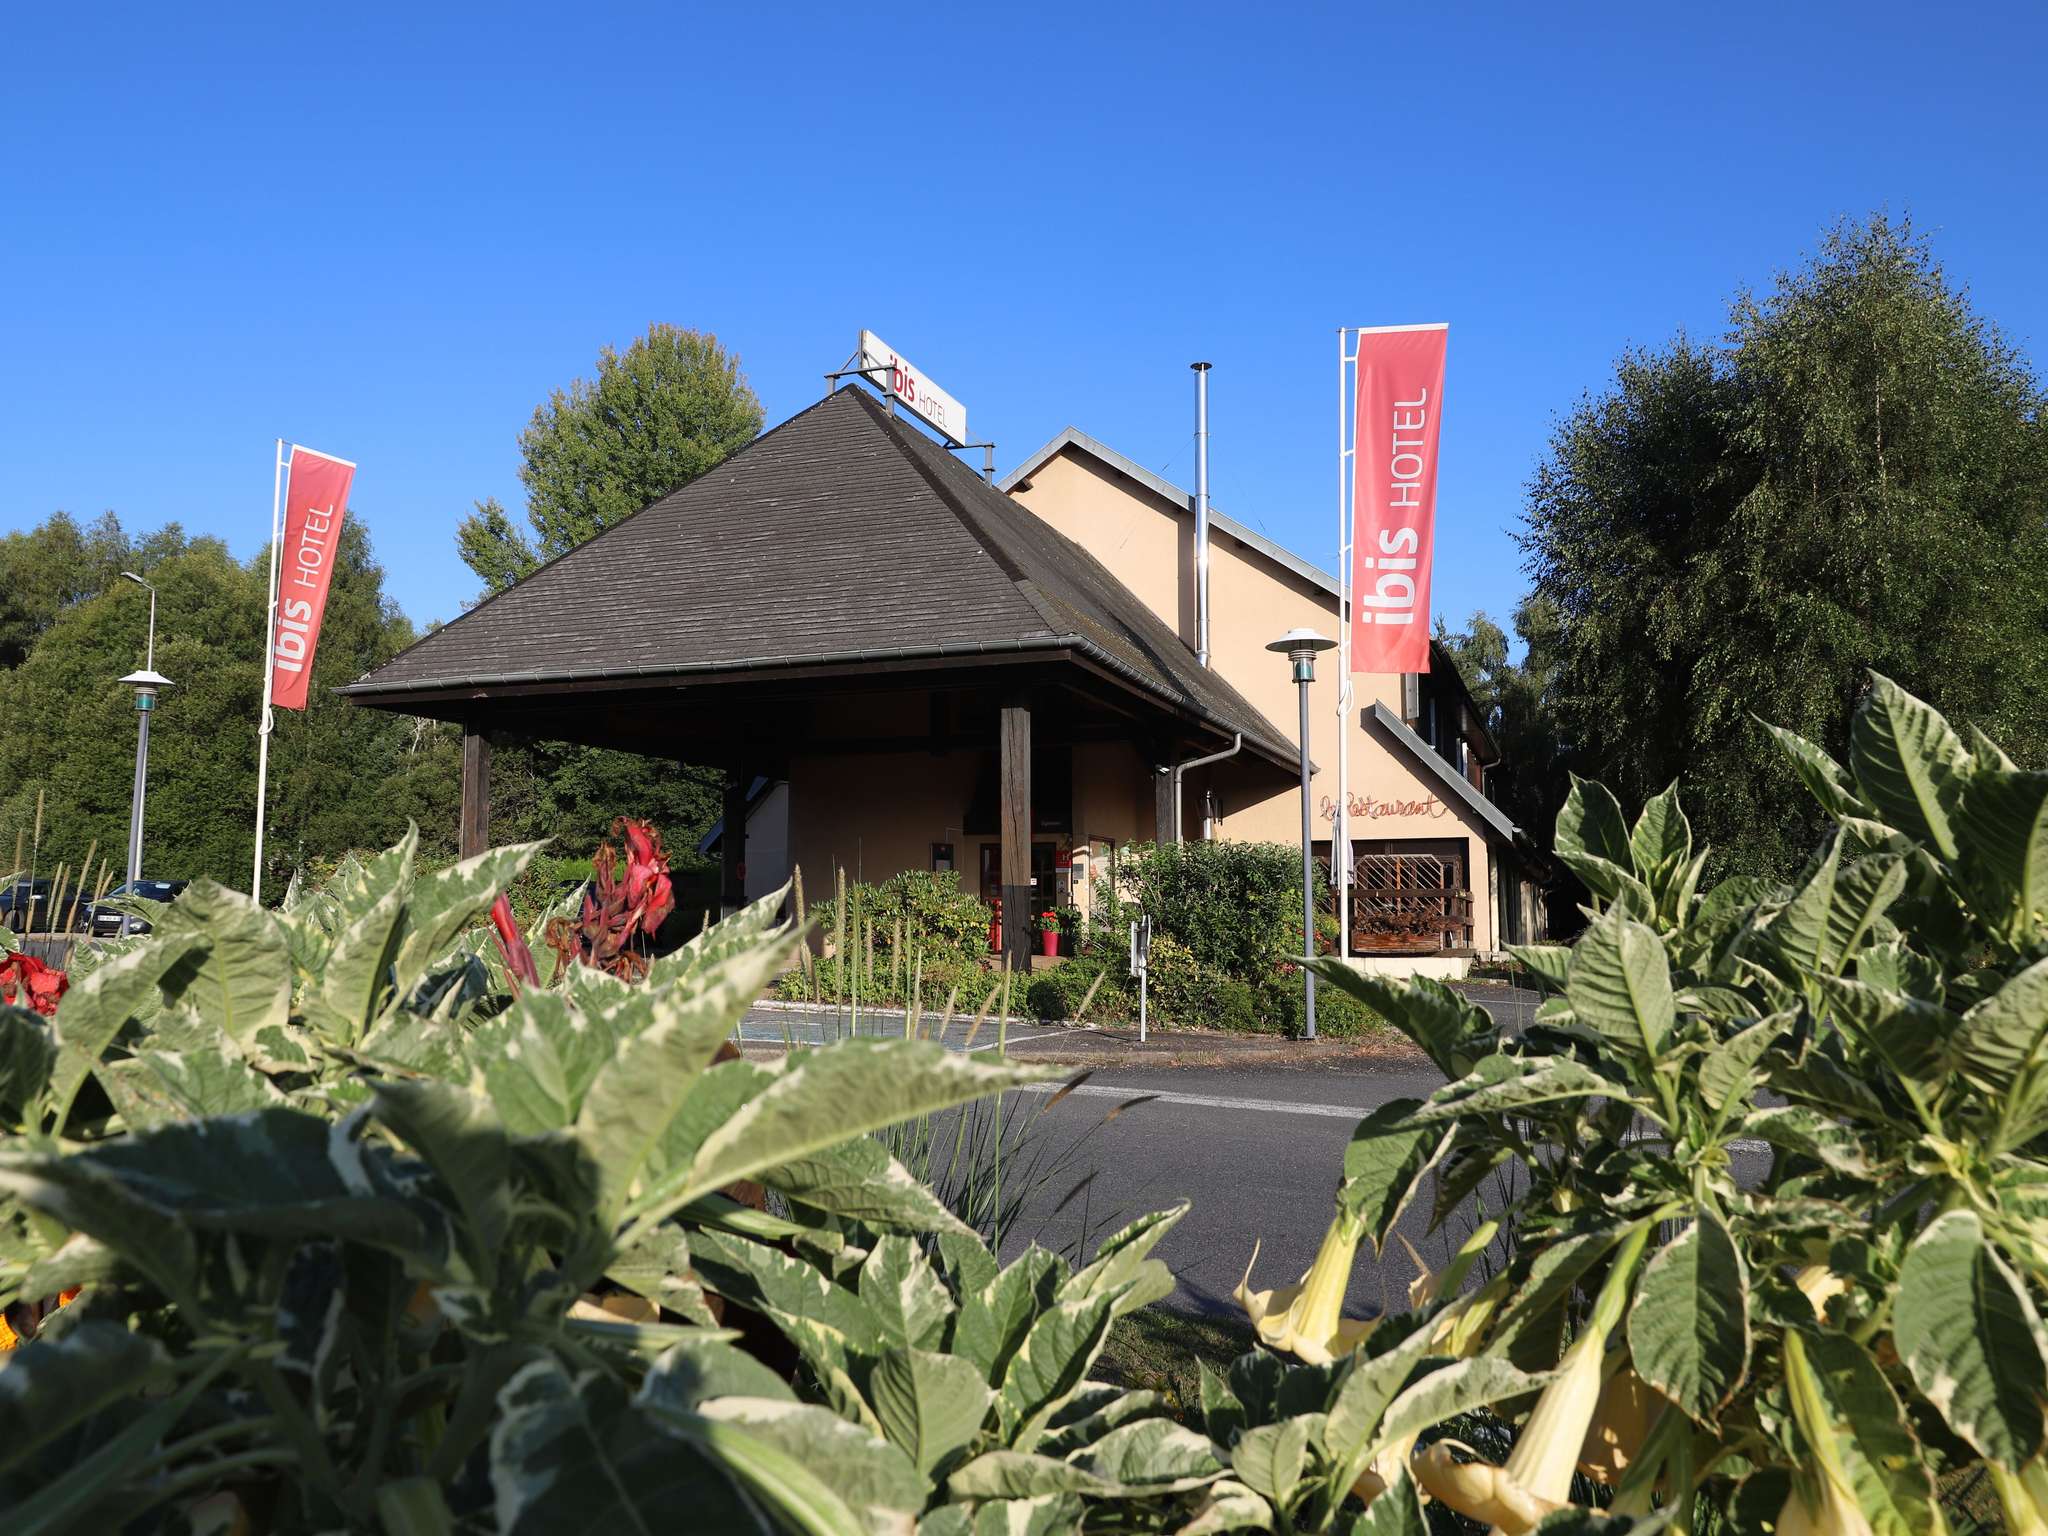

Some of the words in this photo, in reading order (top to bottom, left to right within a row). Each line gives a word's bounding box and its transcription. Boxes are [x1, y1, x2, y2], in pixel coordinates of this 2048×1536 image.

[889, 354, 915, 402] bis
[918, 391, 948, 428] HOTEL
[274, 597, 313, 673] ibis
[294, 504, 334, 588] HOTEL
[1362, 527, 1418, 625] ibis
[1390, 387, 1427, 507] HOTEL
